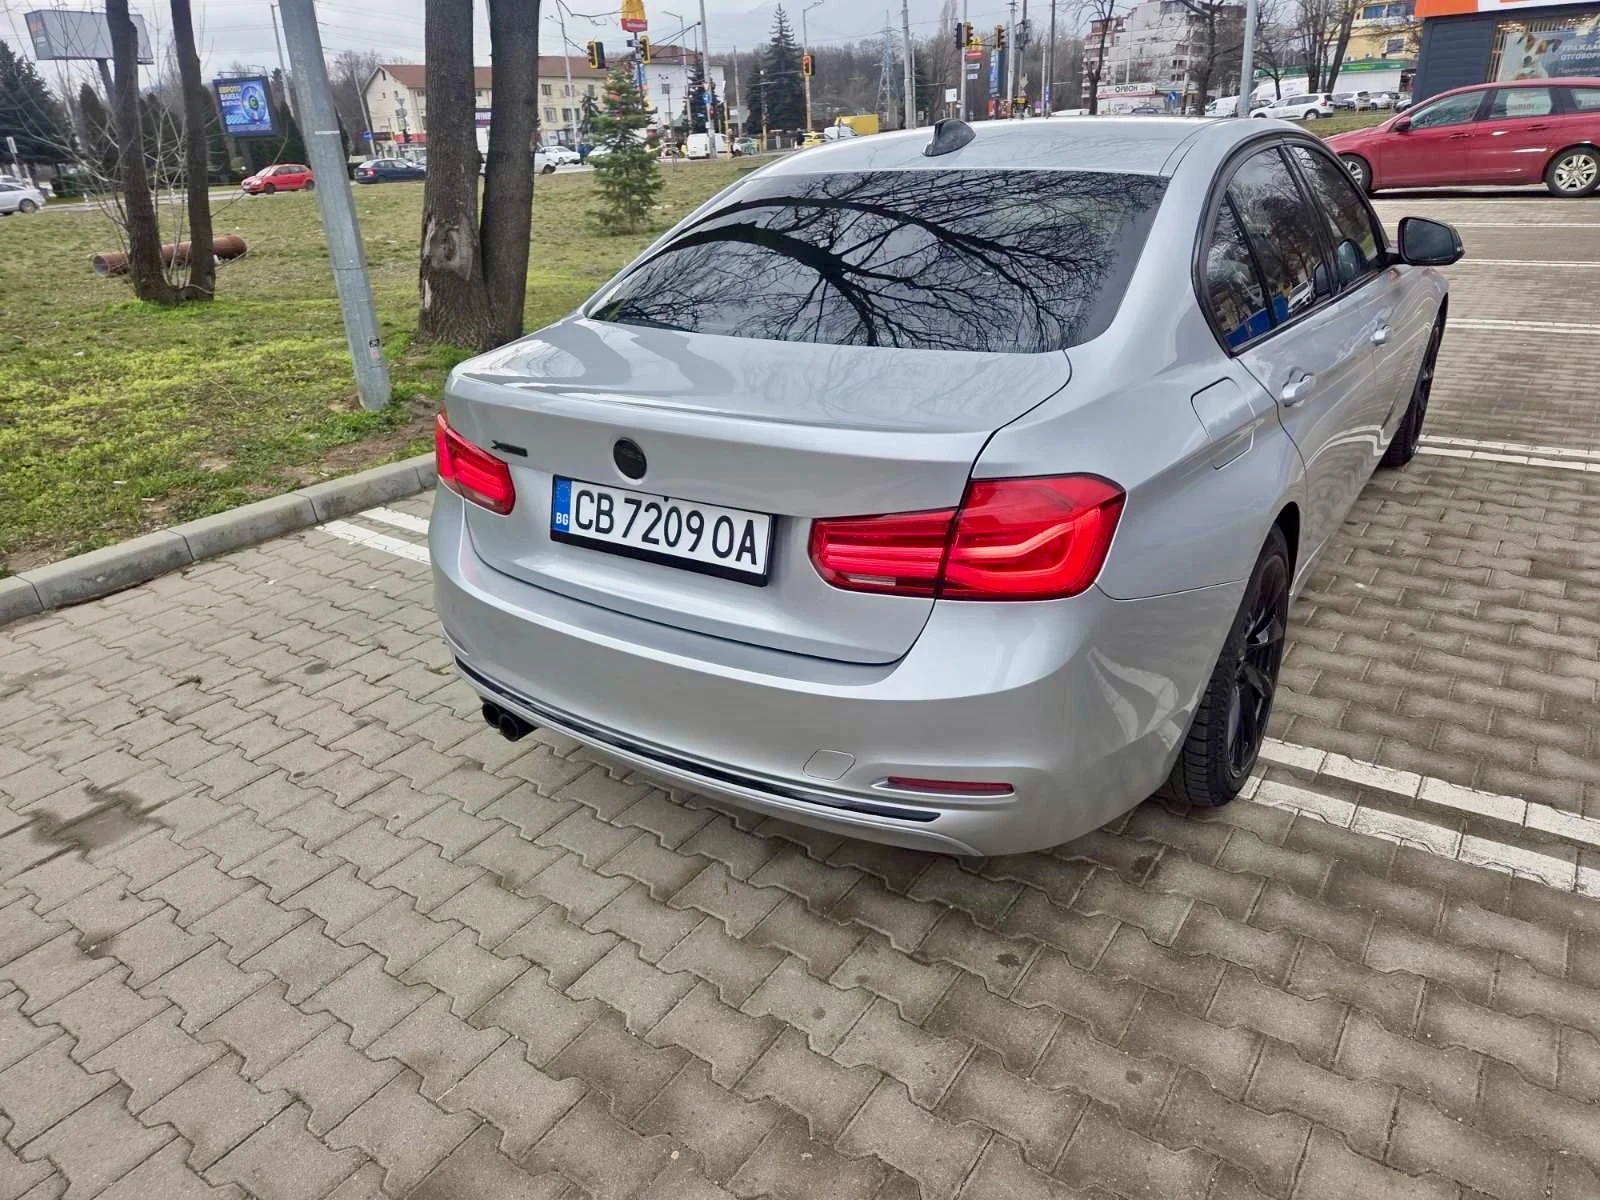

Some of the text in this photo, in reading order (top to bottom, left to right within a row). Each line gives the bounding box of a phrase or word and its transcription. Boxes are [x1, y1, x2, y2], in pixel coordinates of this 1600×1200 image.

[556, 513, 568, 526] BG
[575, 490, 757, 565] CB 7209 OA
